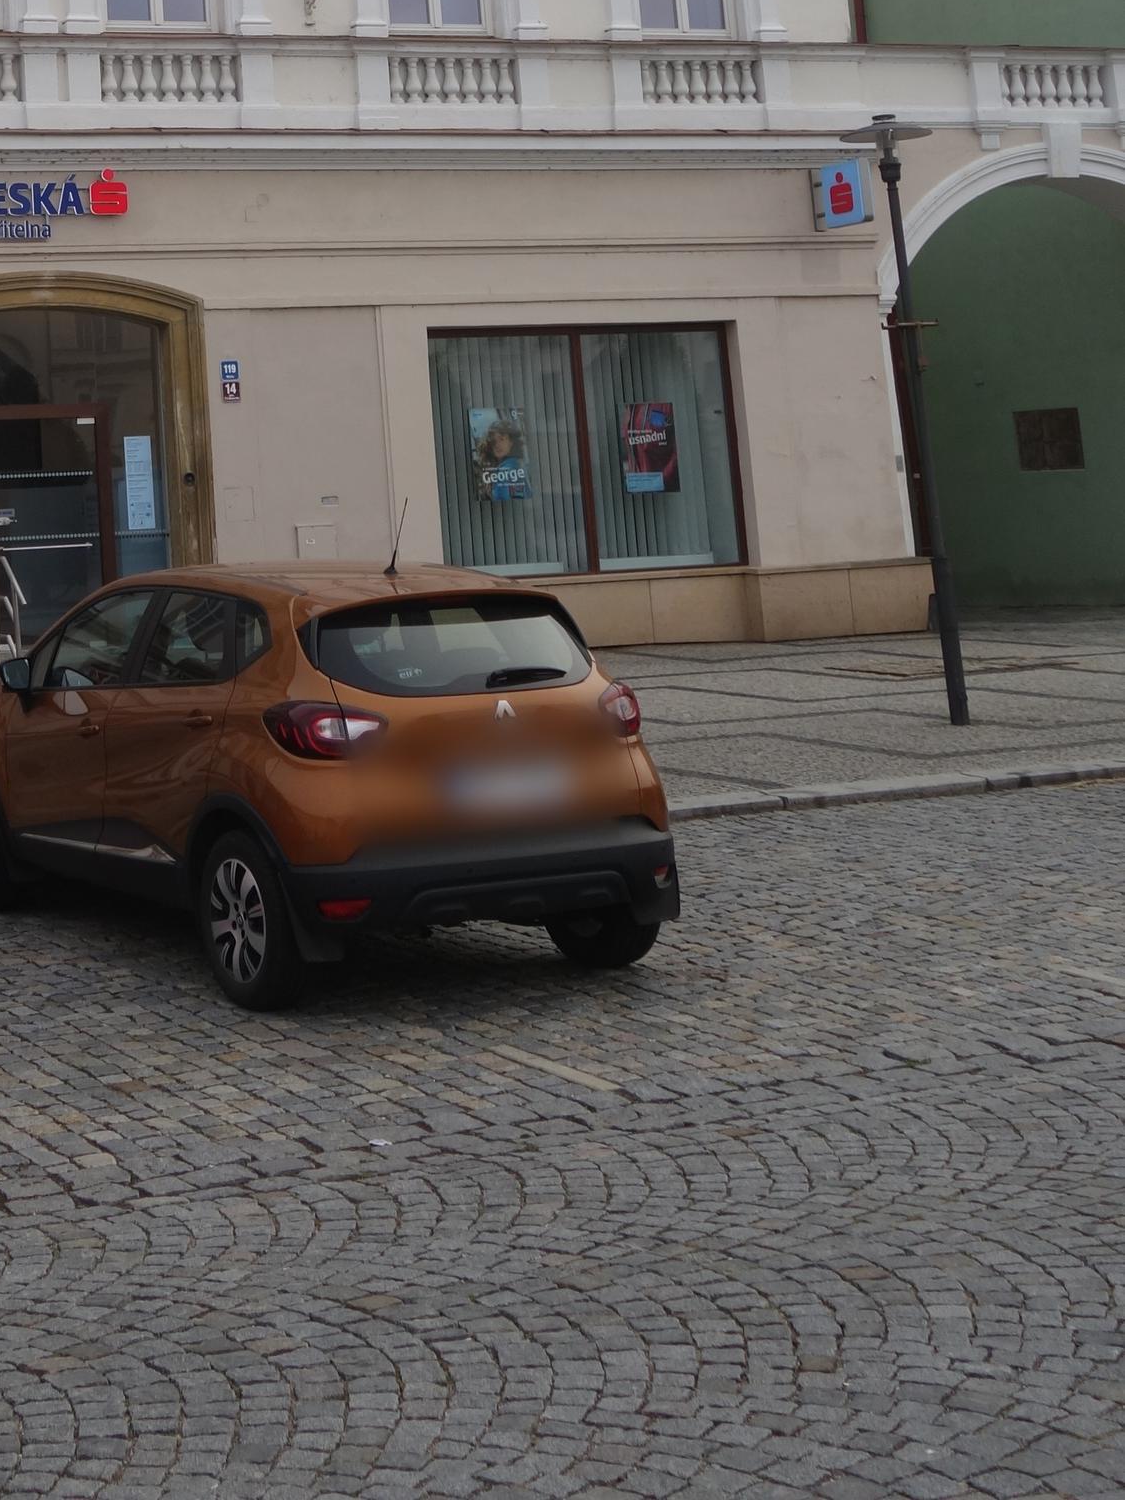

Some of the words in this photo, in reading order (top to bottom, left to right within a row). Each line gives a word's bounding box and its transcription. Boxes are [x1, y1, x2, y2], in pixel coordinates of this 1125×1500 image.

[223, 363, 237, 374] 119
[225, 382, 237, 395] 14
[628, 429, 667, 446] usnadní
[482, 467, 525, 484] George
